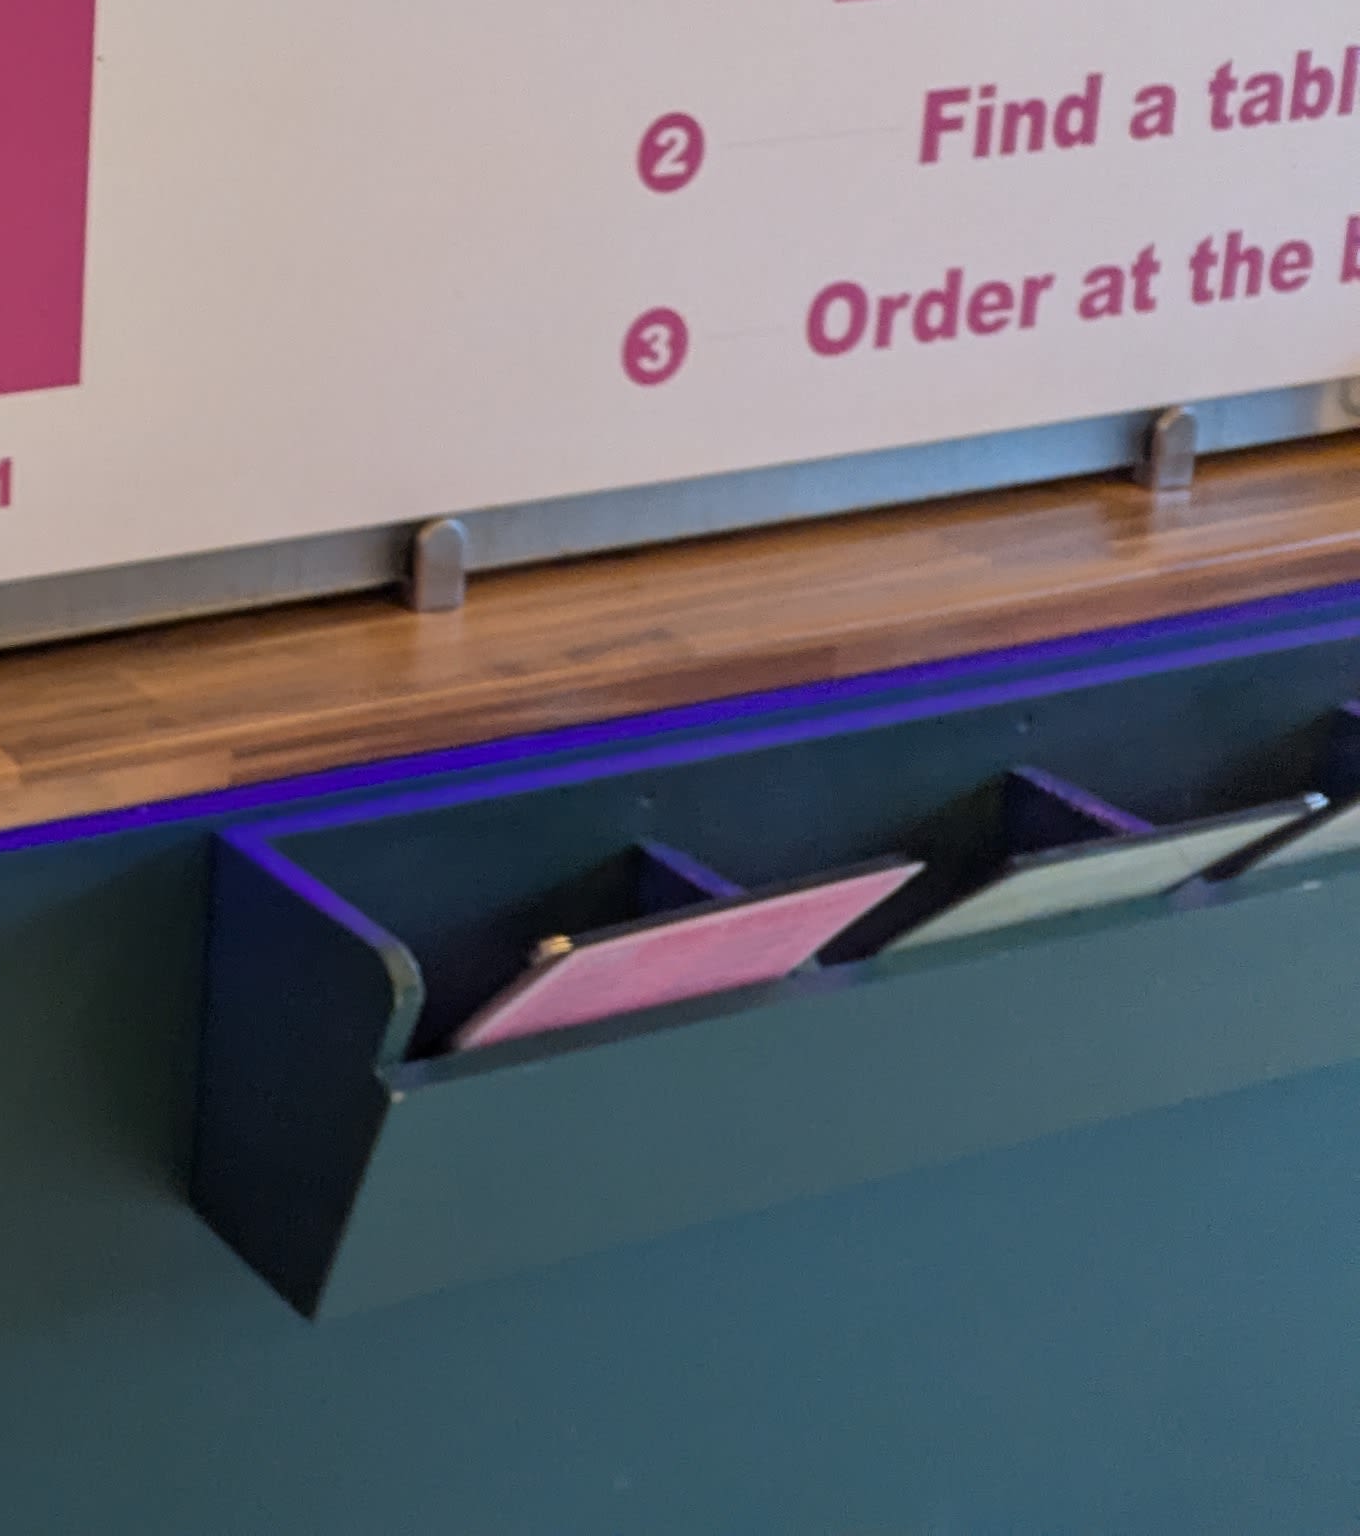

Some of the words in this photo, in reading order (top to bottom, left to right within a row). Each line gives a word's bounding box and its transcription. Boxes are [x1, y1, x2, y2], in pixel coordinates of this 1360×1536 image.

[920, 75, 1101, 162] Find
[1130, 86, 1175, 138] a
[1209, 47, 1358, 129] tabl
[807, 270, 1053, 355] Order
[1079, 245, 1159, 319] at
[1190, 233, 1311, 302] the
